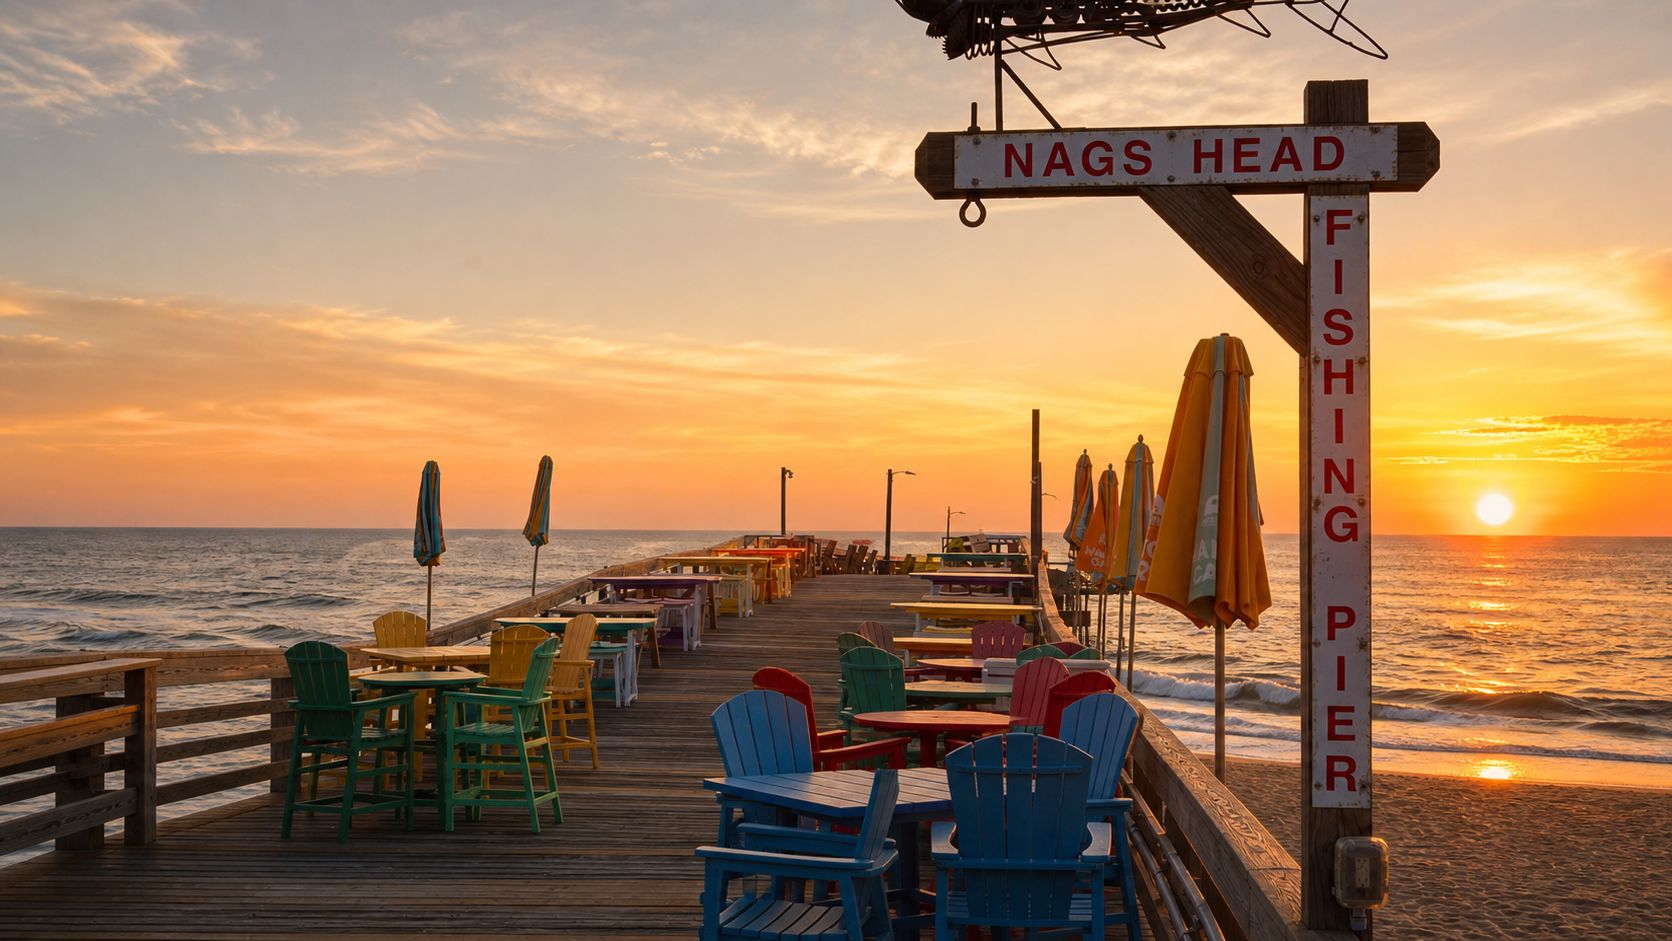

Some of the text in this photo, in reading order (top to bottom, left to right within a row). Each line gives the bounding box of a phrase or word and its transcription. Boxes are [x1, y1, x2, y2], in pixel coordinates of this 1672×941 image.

[1004, 135, 1345, 177] NAGS HEAD
[1323, 209, 1358, 791] FISHING PIER
